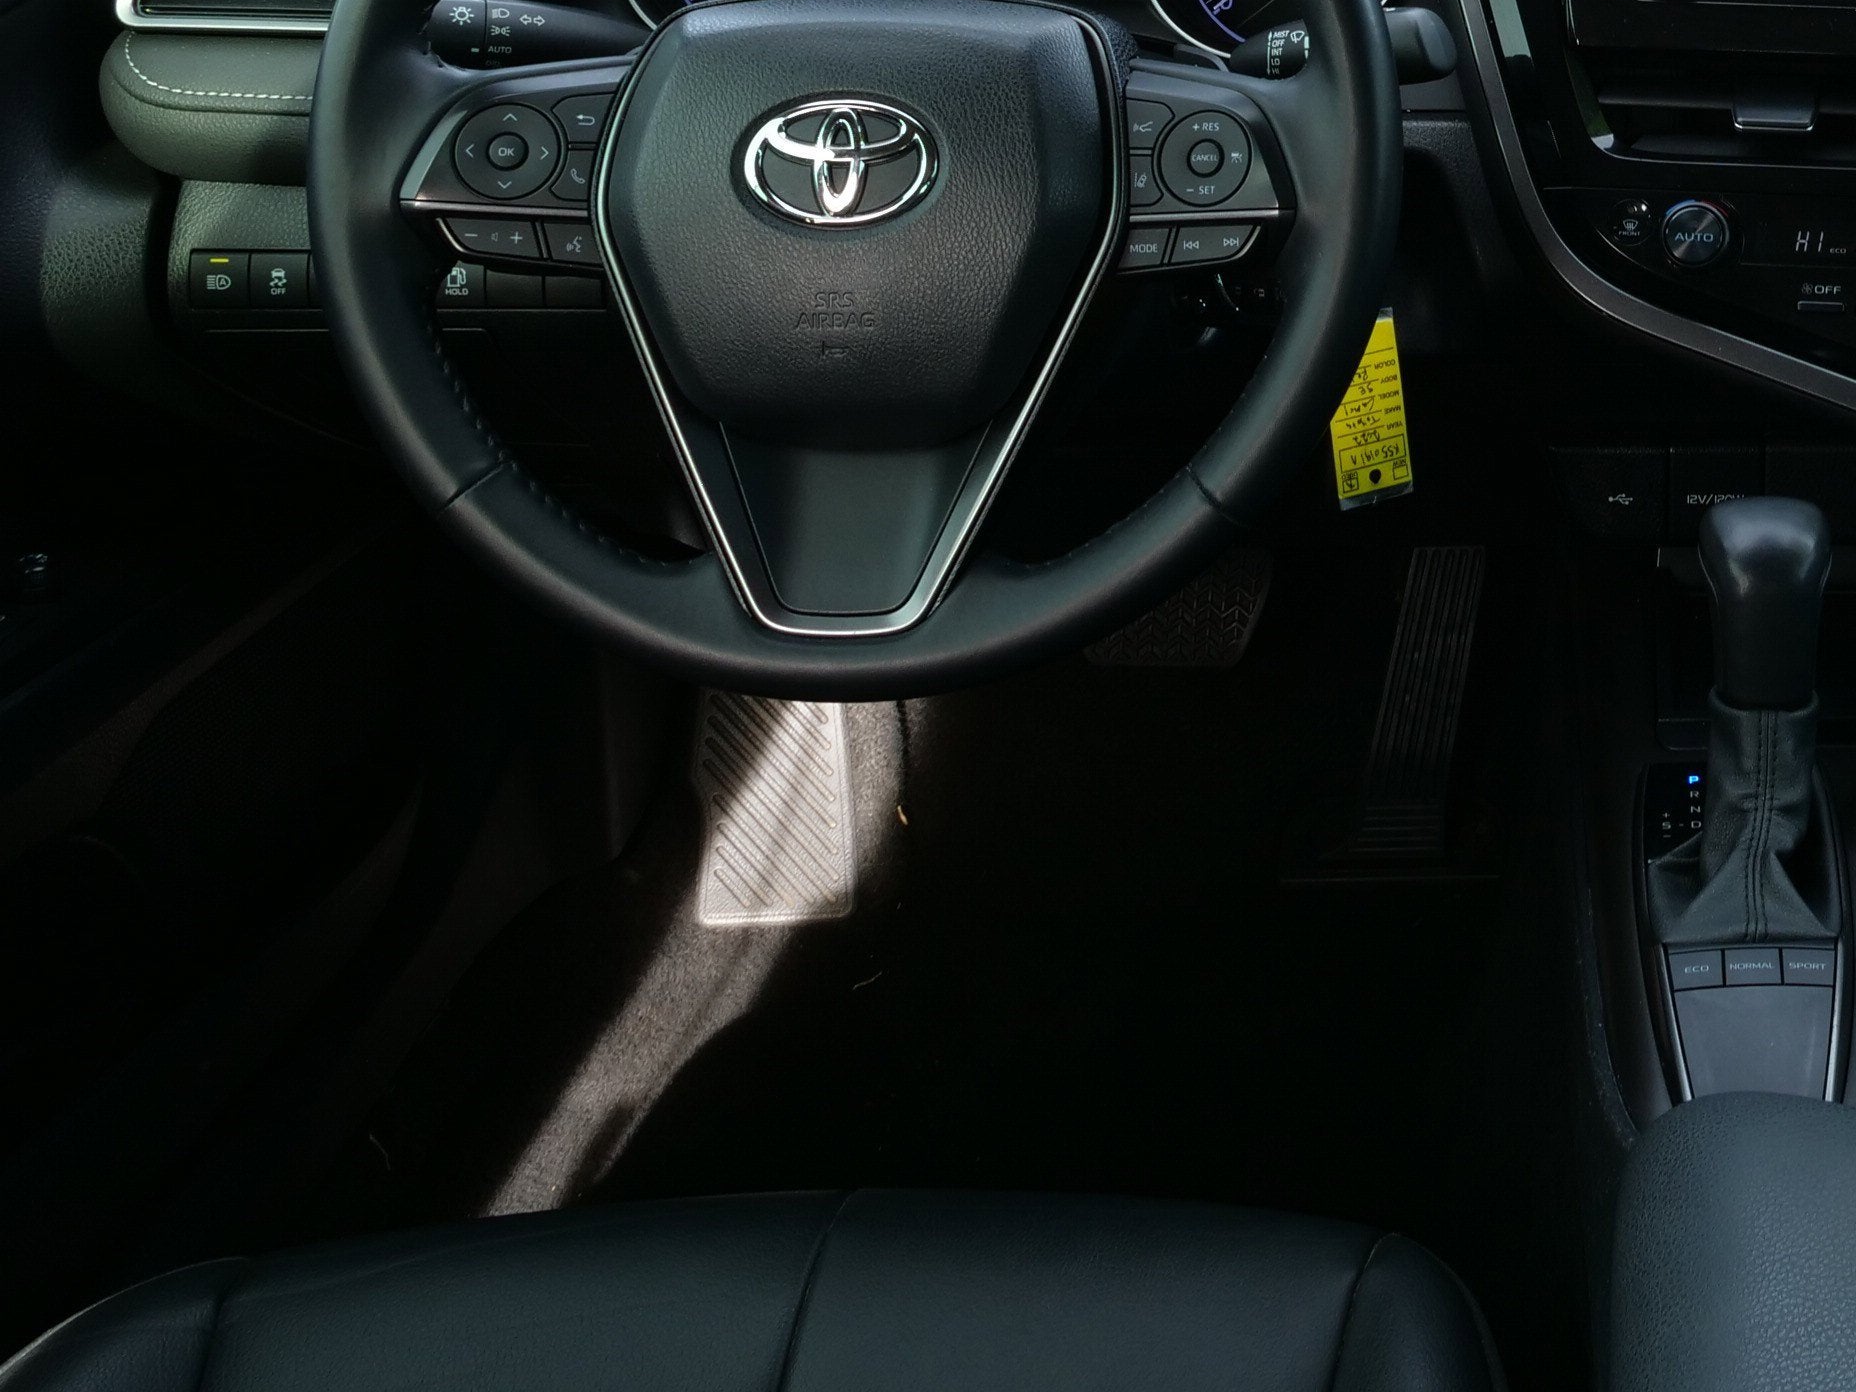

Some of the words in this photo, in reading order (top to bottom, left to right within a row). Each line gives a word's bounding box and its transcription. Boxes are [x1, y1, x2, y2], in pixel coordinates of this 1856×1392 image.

[1272, 30, 1290, 38] MIST
[1271, 40, 1285, 48] OFF
[487, 45, 513, 54] AUTO
[1271, 48, 1283, 57] INT
[1201, 122, 1220, 132] RES
[498, 147, 515, 157] OK
[1191, 154, 1218, 162] CANCEL
[1198, 186, 1216, 195] SET
[1674, 231, 1714, 242] AUTO
[1129, 243, 1158, 254] MODE
[445, 288, 469, 296] HOLD
[1813, 284, 1842, 295] OFF
[814, 291, 855, 309] SRS
[796, 312, 877, 330] AIRBAG
[1374, 359, 1396, 371] COLOR
[1379, 374, 1398, 385] BODY
[1378, 390, 1400, 401] MODEL
[1384, 405, 1402, 415] MAKE
[1386, 420, 1404, 431] YEAR
[1689, 775, 1699, 784] P
[1690, 790, 1700, 798] R
[1691, 820, 1702, 828] D
[1684, 964, 1709, 974] ECO
[1729, 961, 1774, 970] NORMAL
[1789, 961, 1827, 970] SPORT
